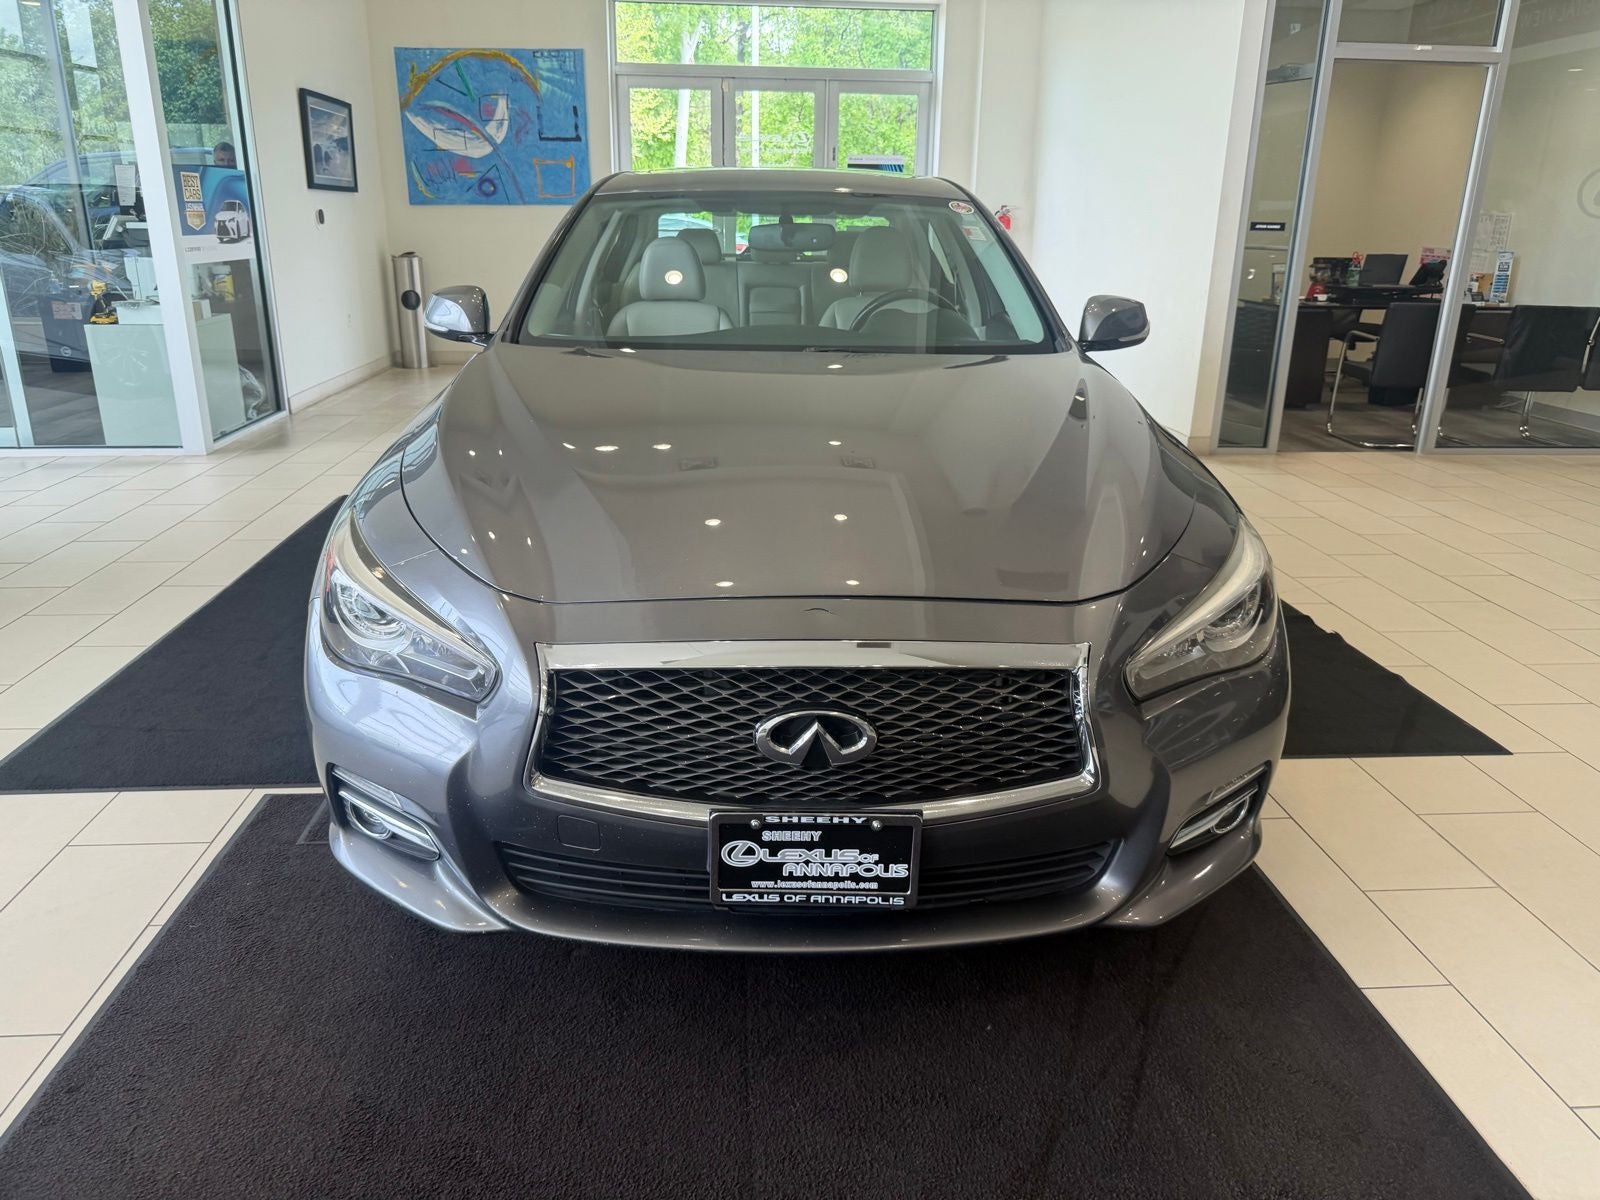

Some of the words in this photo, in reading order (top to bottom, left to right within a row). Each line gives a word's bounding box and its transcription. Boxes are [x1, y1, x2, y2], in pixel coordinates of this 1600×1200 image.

[182, 175, 199, 188] BEST
[184, 188, 201, 200] CARS
[765, 816, 866, 824] SHEEHY
[762, 831, 822, 841] SHEEHY
[760, 848, 859, 863] LEXUS
[783, 863, 909, 877] ANNAPOLIS
[751, 880, 878, 890] www.lexusofannapolis.com
[722, 893, 780, 902] LEXUS
[810, 895, 905, 905] ANNAPOLIS
